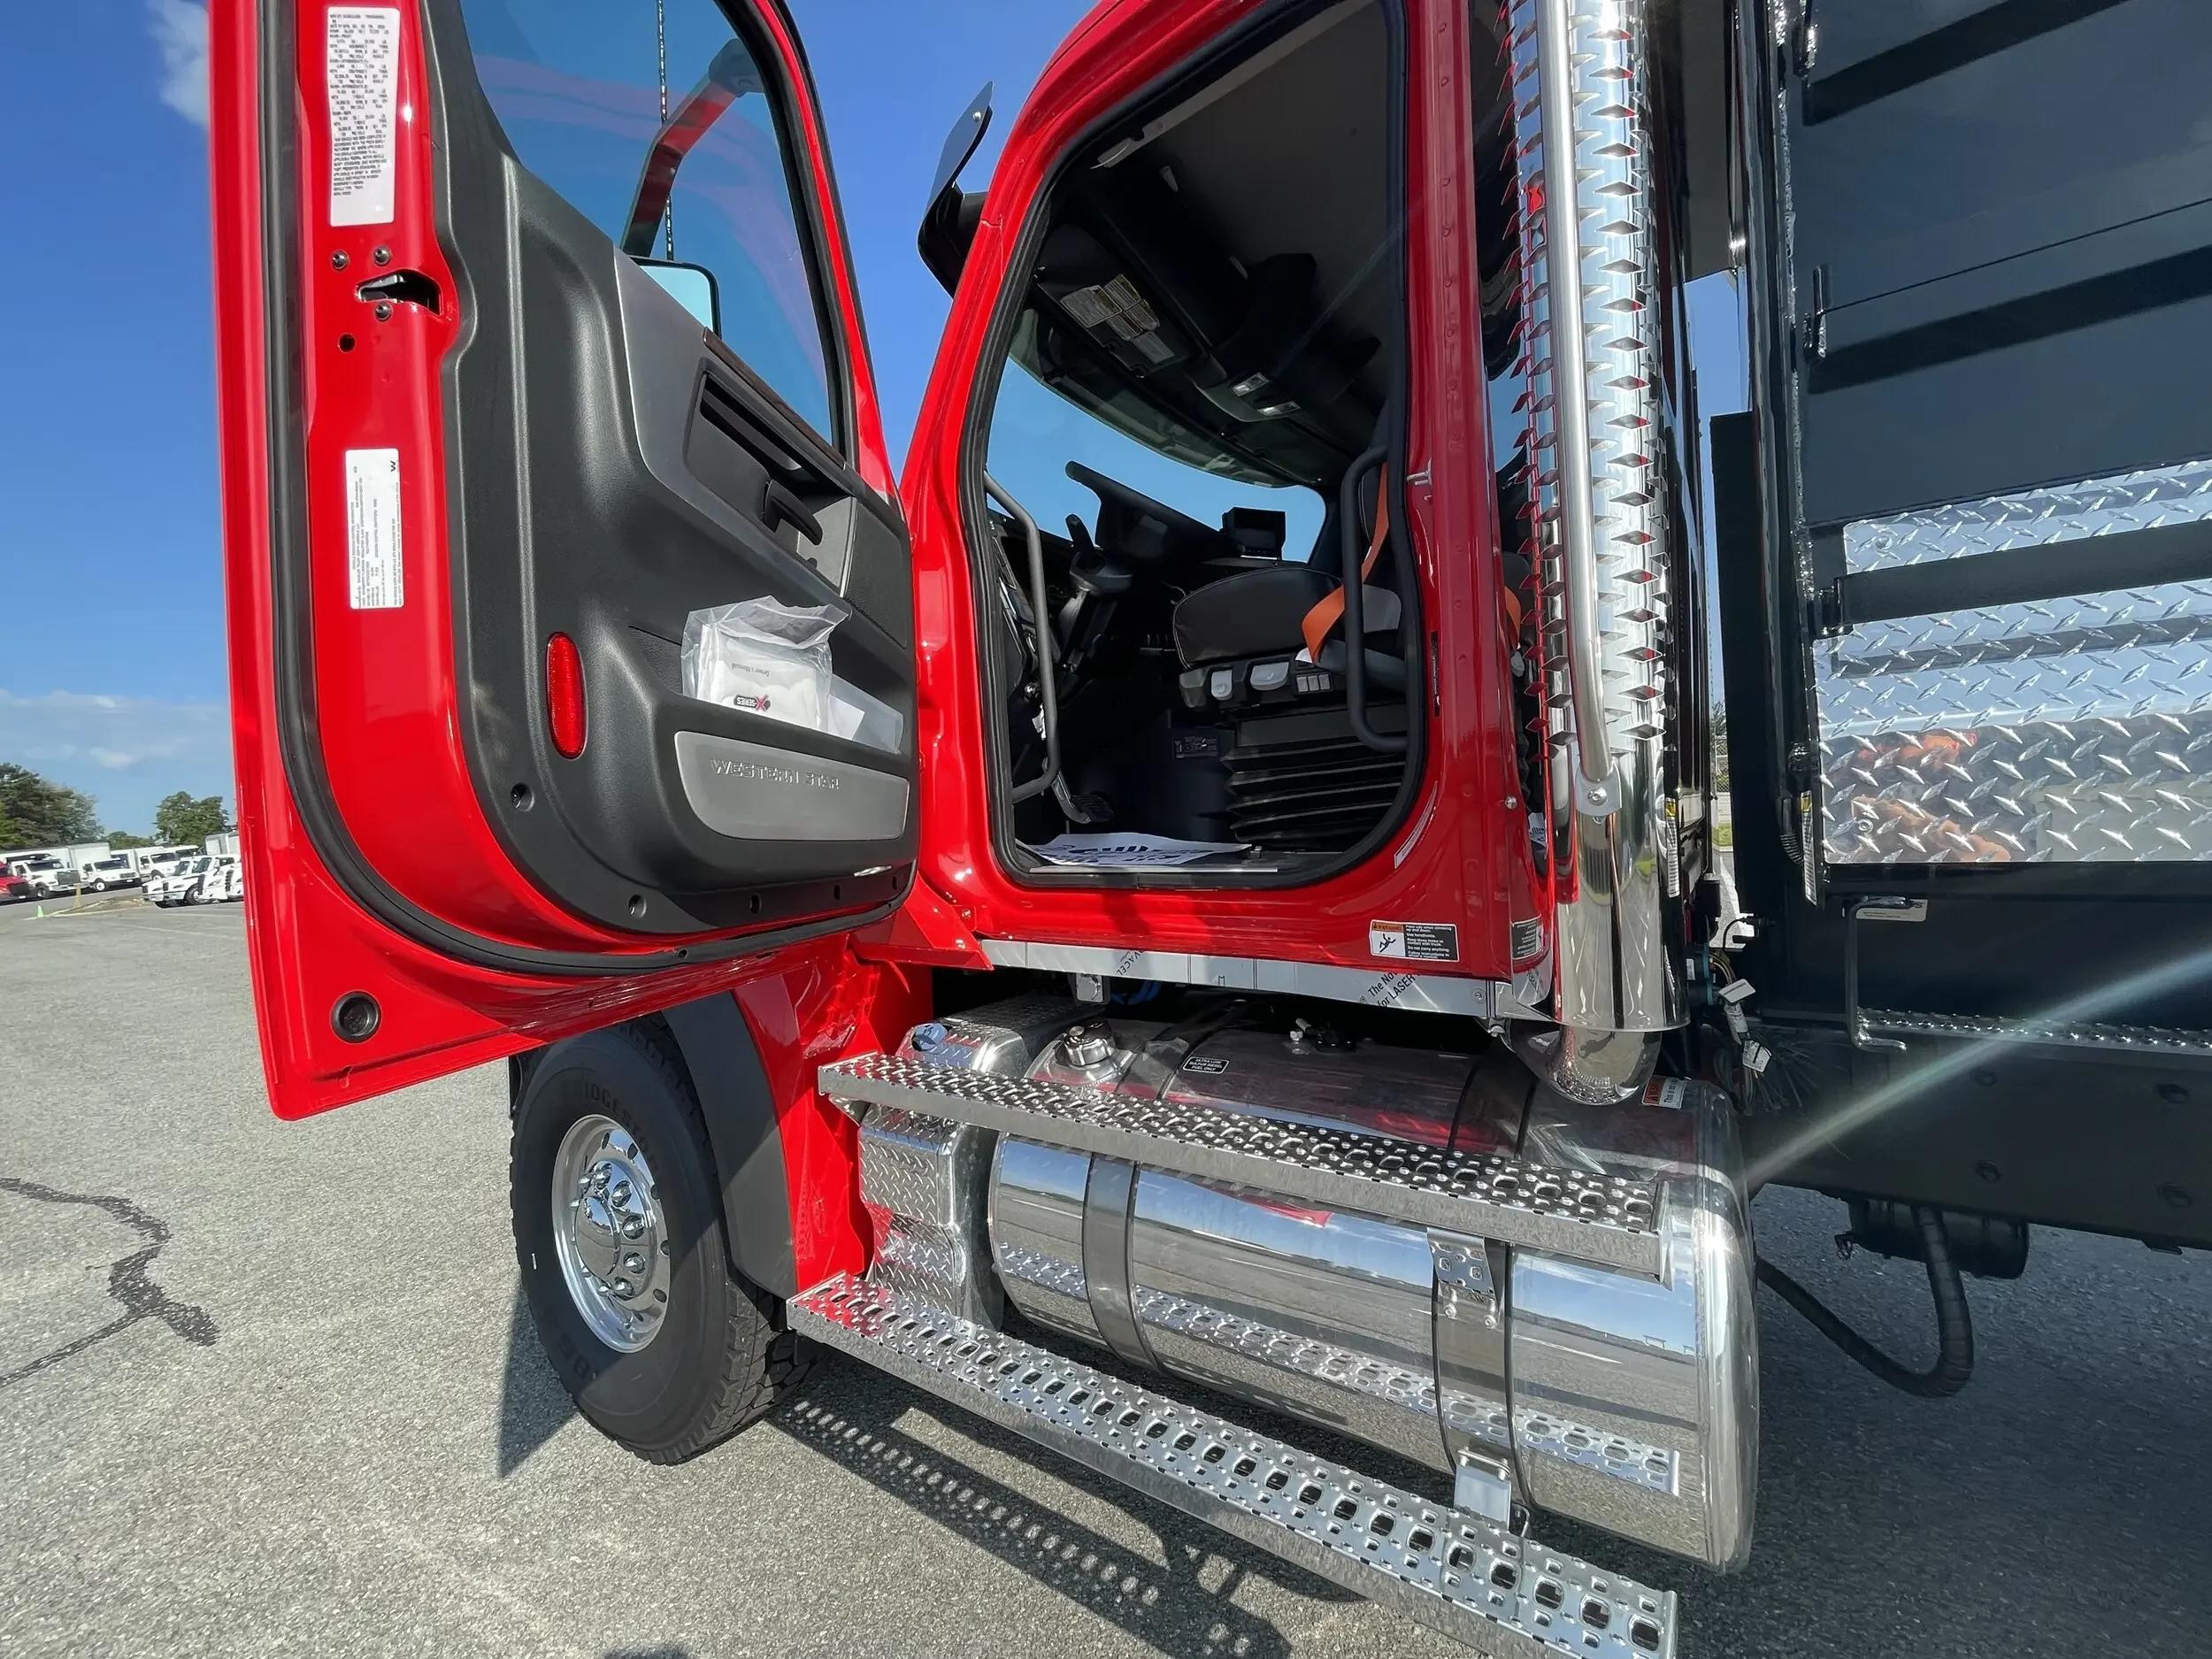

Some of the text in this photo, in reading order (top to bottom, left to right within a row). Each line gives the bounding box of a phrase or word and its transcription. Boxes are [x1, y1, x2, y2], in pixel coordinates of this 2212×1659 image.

[710, 759, 840, 790] WESTERN STAR
[1367, 982, 1384, 996] The
[1387, 973, 1417, 1000] LASER
